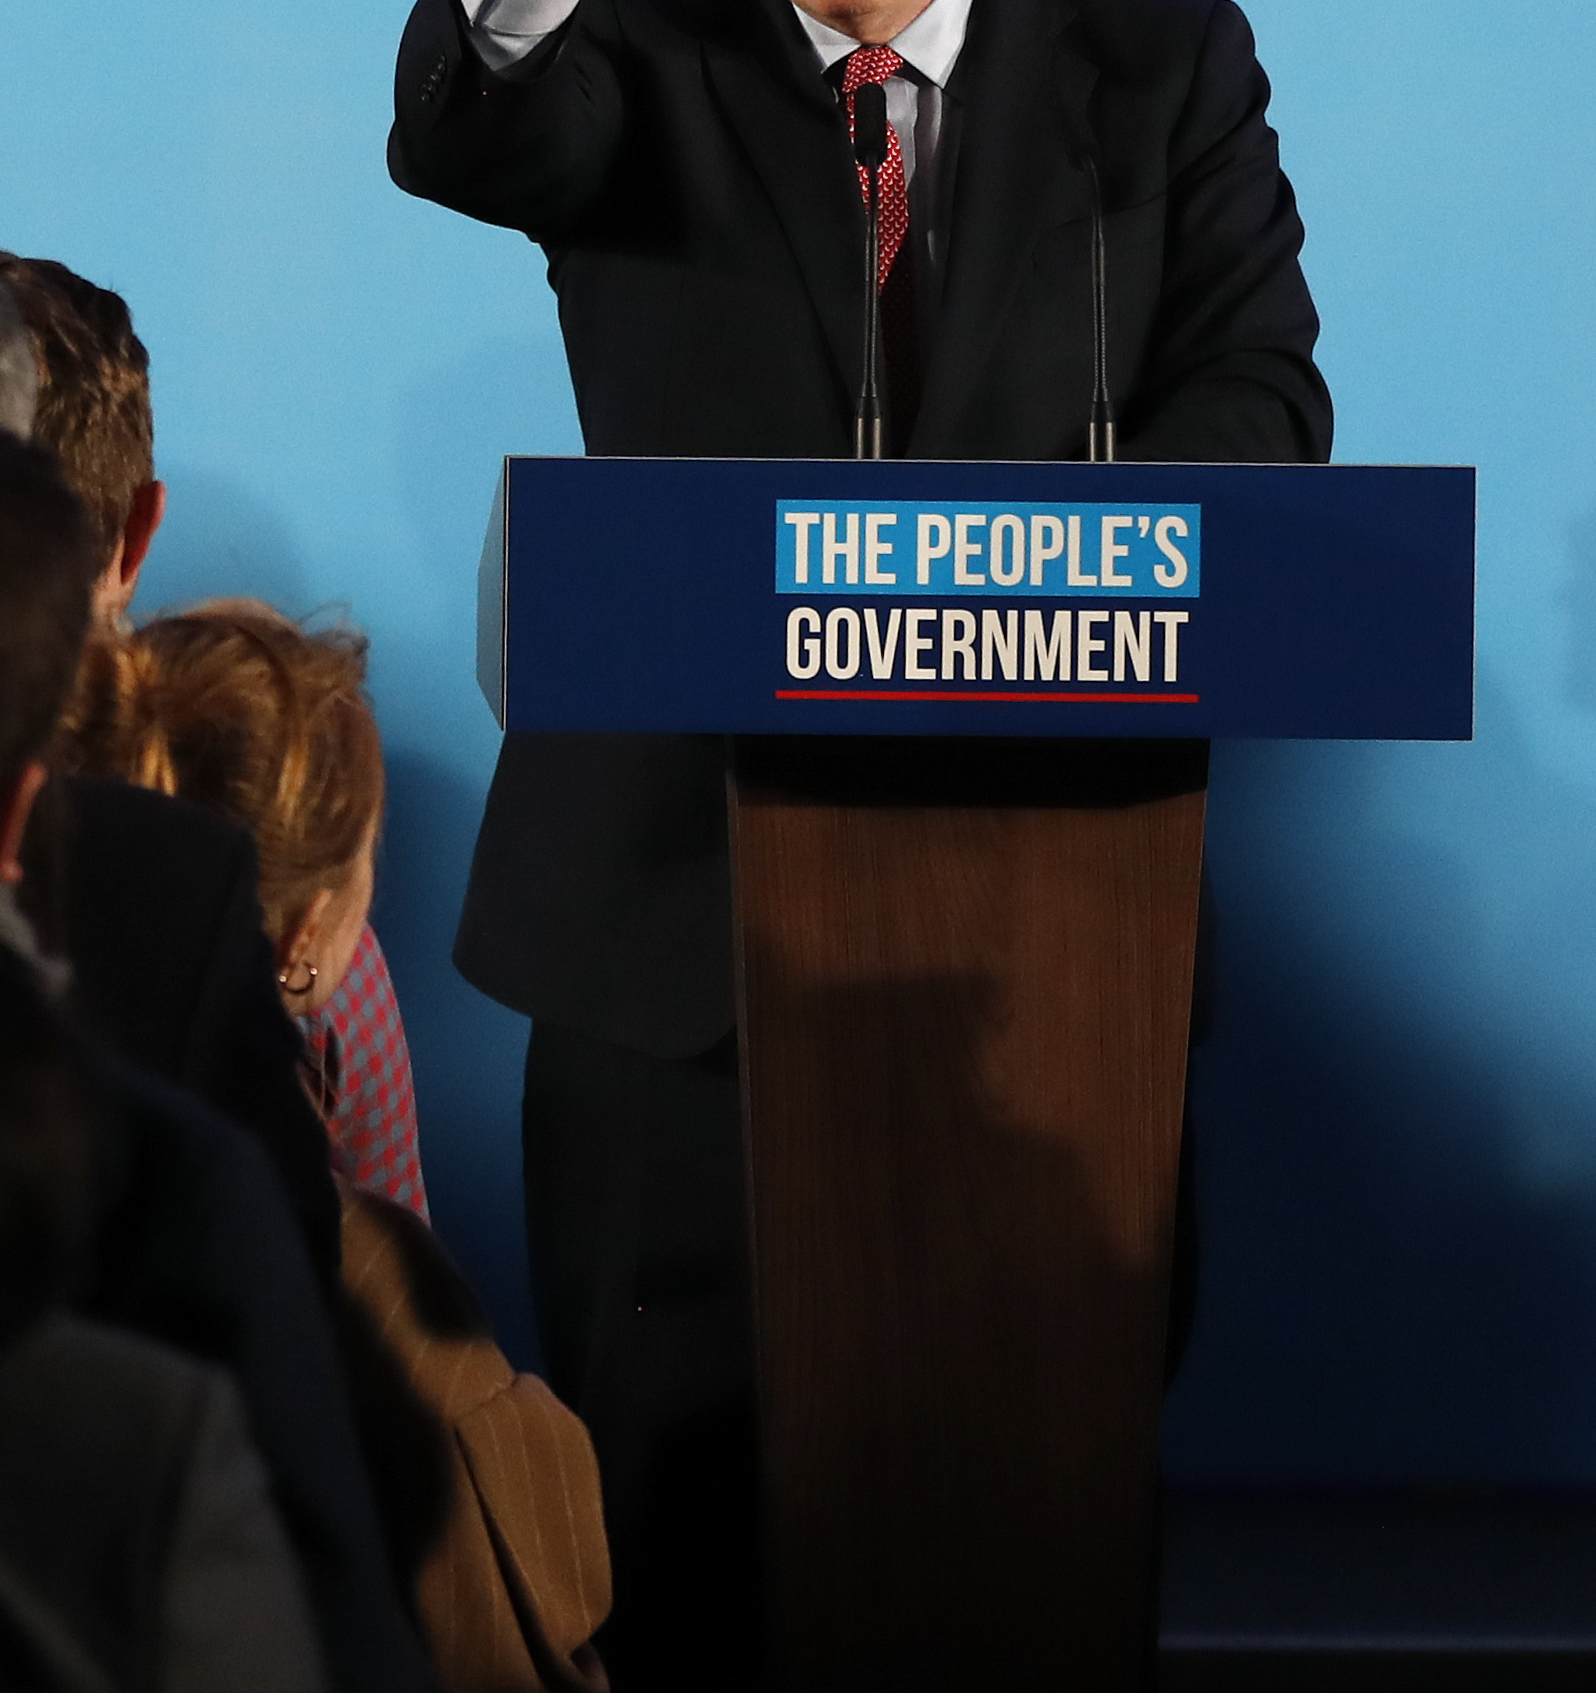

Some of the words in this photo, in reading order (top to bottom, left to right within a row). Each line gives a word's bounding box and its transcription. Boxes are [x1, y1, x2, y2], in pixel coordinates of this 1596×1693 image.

[784, 512, 898, 585] THE
[916, 513, 1189, 589] PEOPLE’S
[786, 606, 1190, 683] GOVERNMENT
